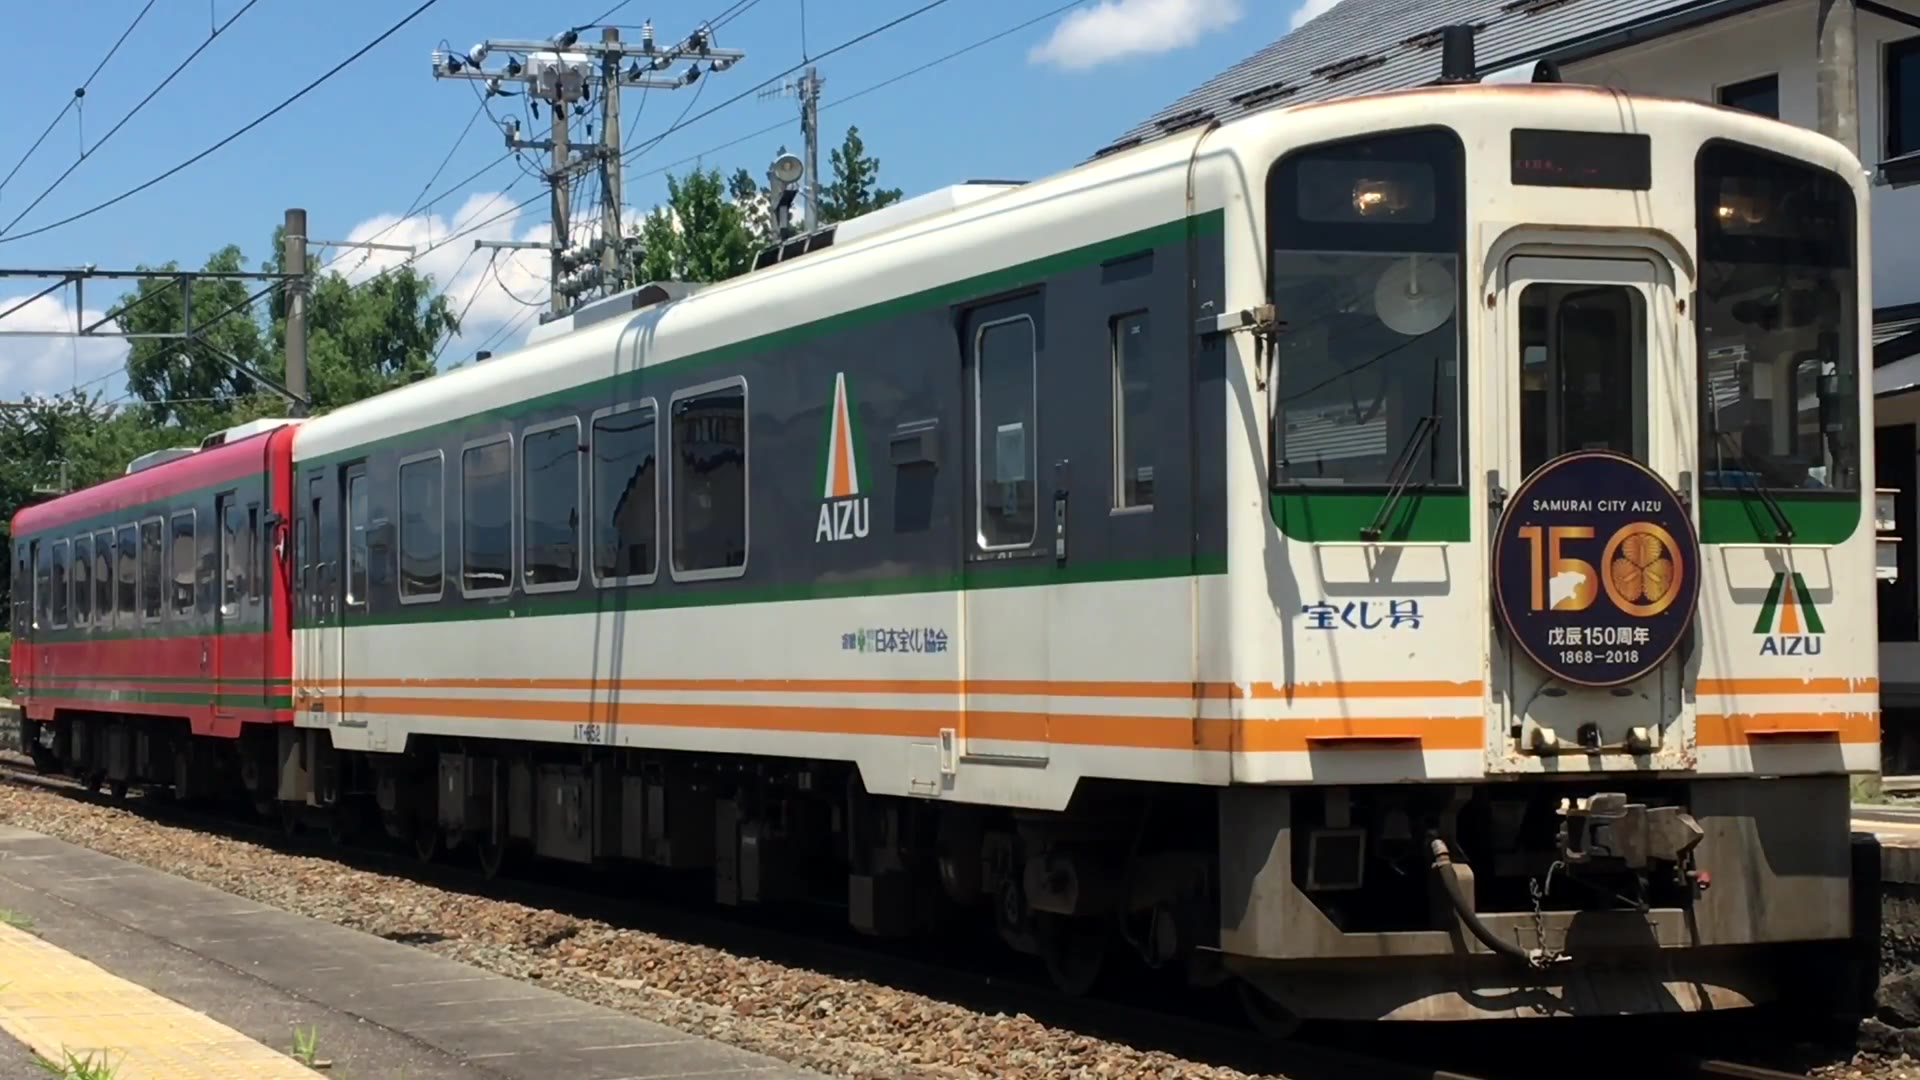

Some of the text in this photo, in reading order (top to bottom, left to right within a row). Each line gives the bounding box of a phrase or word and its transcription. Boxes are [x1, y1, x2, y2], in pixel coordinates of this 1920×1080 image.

[1532, 499, 1662, 513] SAMURAI CITY AIZU
[815, 497, 870, 543] AIZU
[1518, 521, 1684, 617] 150
[1301, 599, 1424, 630] 宝くじ号
[1548, 626, 1650, 646] 戊辰150周年
[1758, 636, 1821, 656] AIZU
